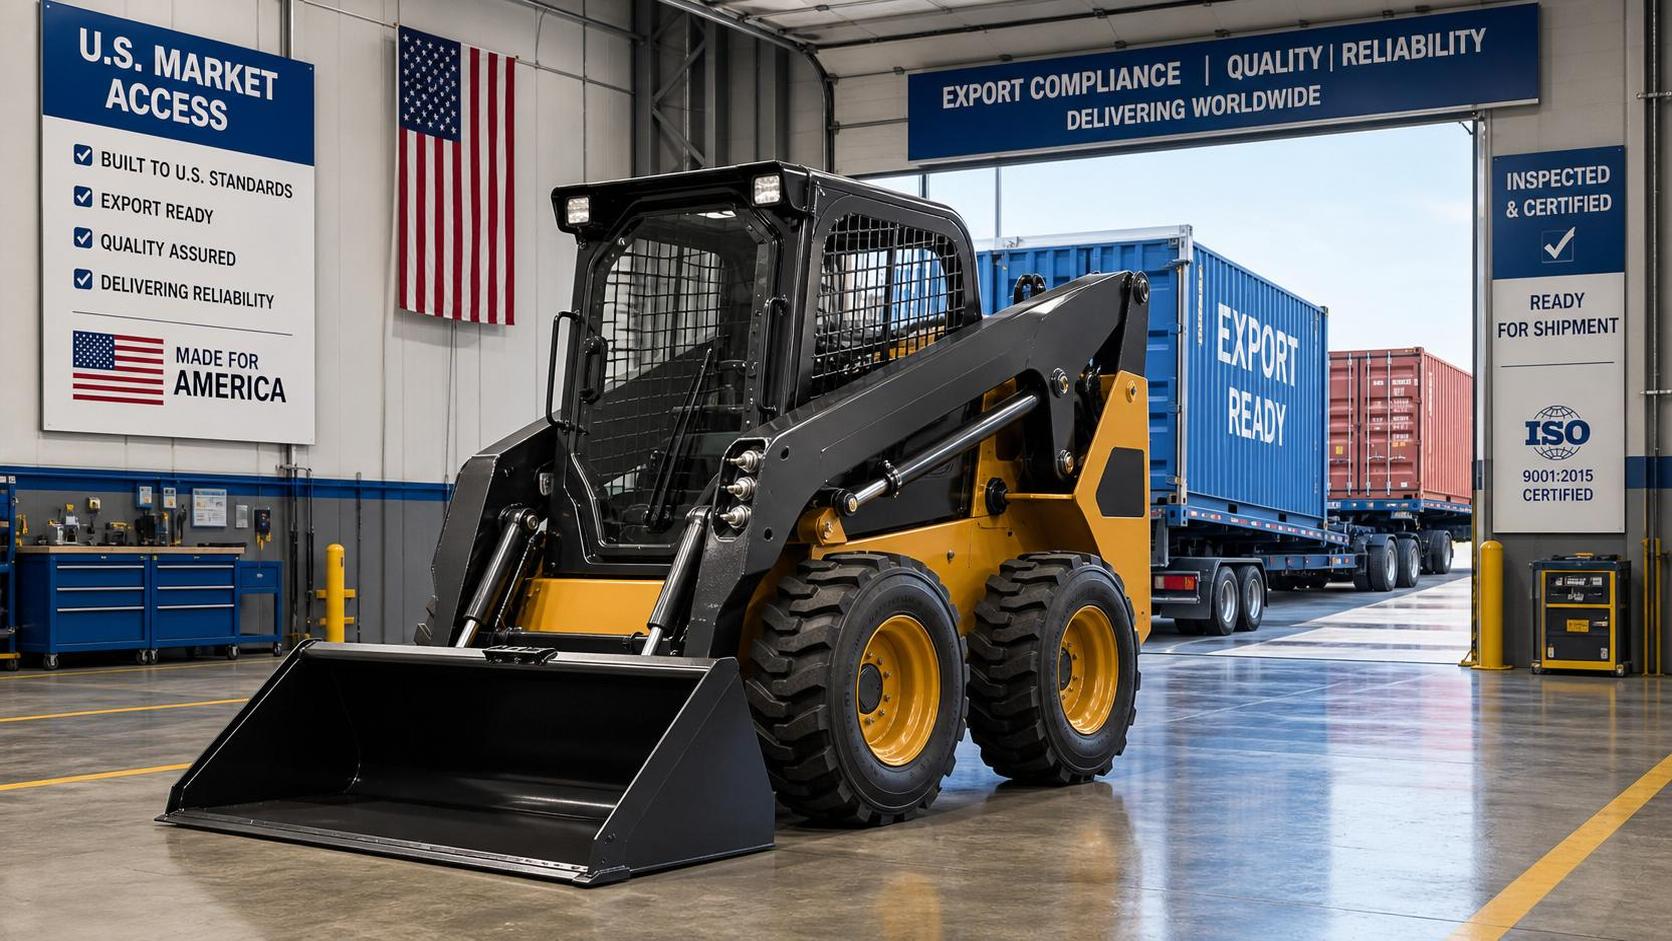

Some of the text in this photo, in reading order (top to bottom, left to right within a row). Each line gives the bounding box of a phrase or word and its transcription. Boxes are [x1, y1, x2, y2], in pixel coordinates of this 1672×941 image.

[79, 27, 279, 101] U.S. MARKET
[942, 27, 1487, 110] EXPORT COMPLIANCE QUALITY RELIABILITY
[105, 78, 228, 132] ACCESS
[1066, 84, 1322, 131] DELIVERING WORLDWIDE
[101, 150, 293, 199] BUILT TO U.S. STANDARDS
[1506, 165, 1611, 191] INSPECTED
[101, 192, 214, 225] EXPORT READY
[1505, 193, 1612, 219] & CERTIFIED
[100, 233, 236, 267] QUALITY ASSURED
[101, 274, 275, 310] DELIVERING RELIABILITY
[1530, 292, 1585, 311] READY
[1217, 302, 1299, 387] EXPORT
[1497, 316, 1620, 339] FOR SHIPMENT
[176, 346, 259, 371] MADE FOR
[173, 369, 287, 404] AMERICA
[1228, 386, 1287, 447] READY
[1524, 420, 1591, 446] ISO
[1522, 468, 1594, 483] 9001:2015
[1522, 487, 1594, 502] CERTIFIED
